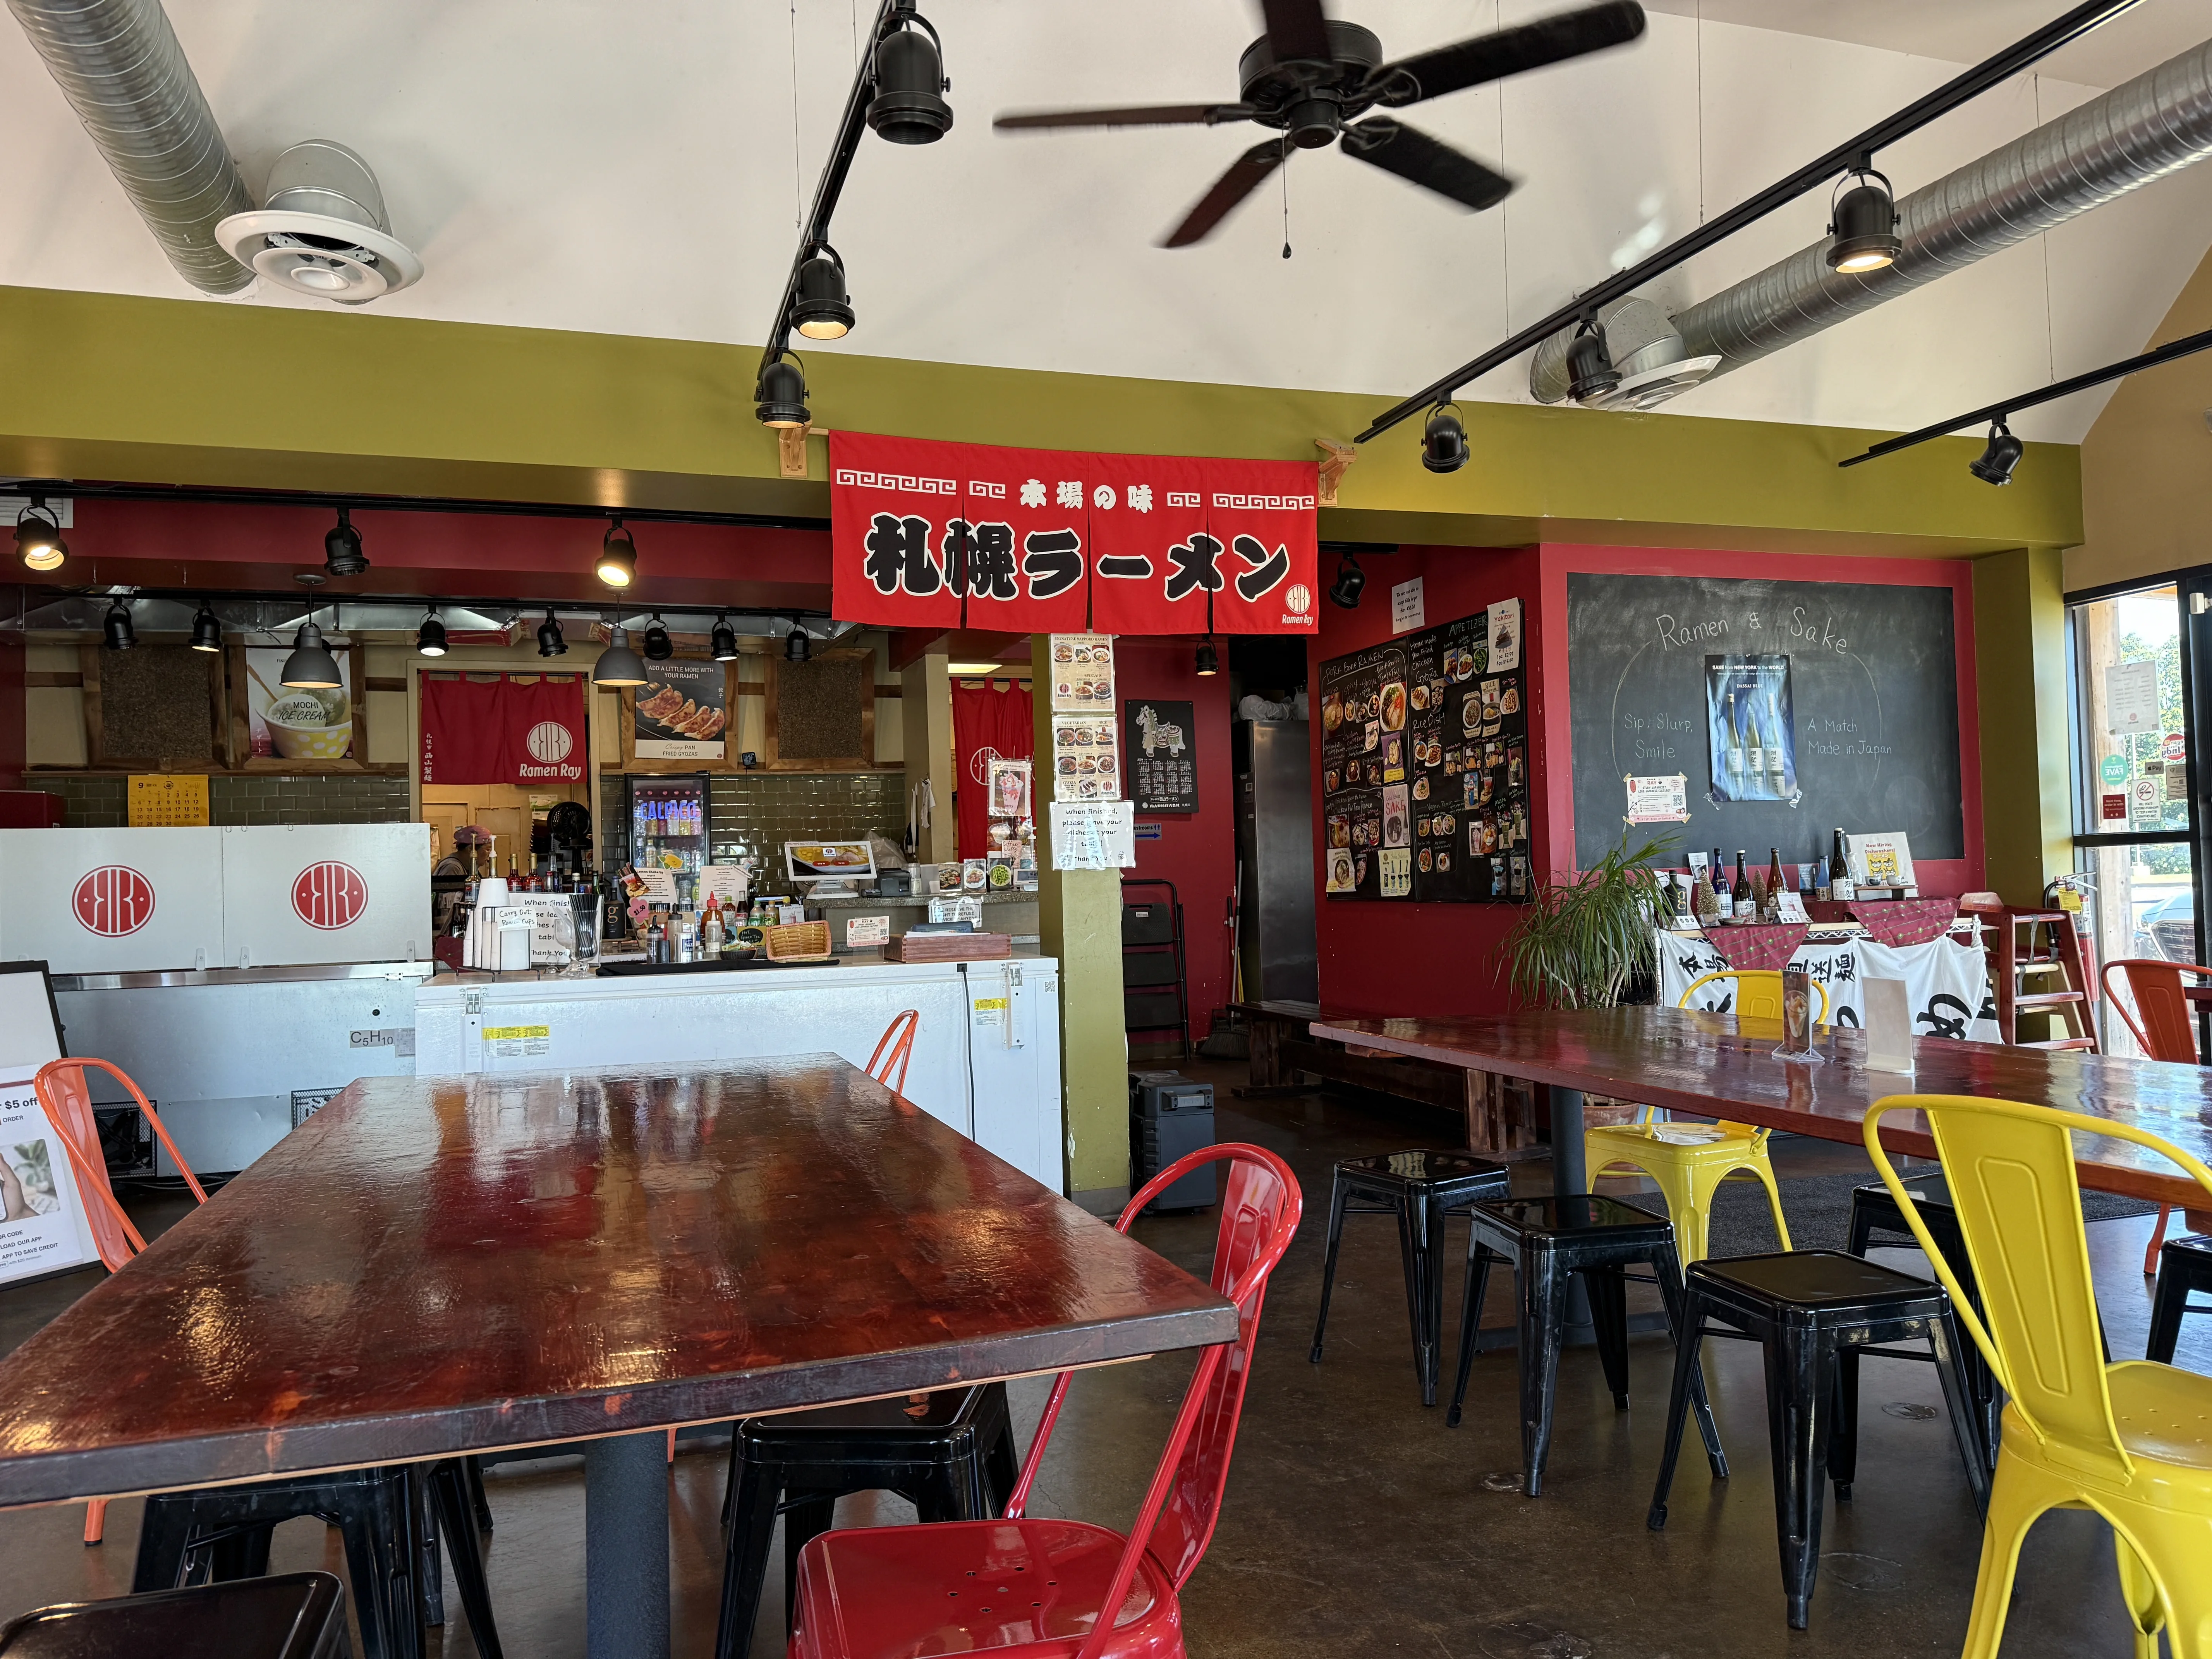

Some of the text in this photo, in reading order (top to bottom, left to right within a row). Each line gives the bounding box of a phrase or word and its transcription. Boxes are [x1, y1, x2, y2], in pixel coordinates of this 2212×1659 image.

[1020, 478, 1153, 514] 本場の味
[863, 511, 1290, 603] 札幌ラーメン
[1282, 614, 1313, 626] Ramen Ray
[1494, 613, 1514, 622] Yakitori
[1656, 613, 1729, 651] Ramen
[1790, 606, 1847, 655] Sake
[279, 711, 331, 721] ICE CREAM
[1657, 712, 1692, 733] Slurp,
[1808, 719, 1858, 734] A Match
[1635, 738, 1675, 759] Smile
[1808, 740, 1892, 757] Made in Japan
[519, 763, 581, 780] Ramen Ray
[640, 801, 696, 820] CALPICO
[1386, 800, 1405, 815] SAKE
[607, 907, 618, 923] g
[634, 905, 646, 915] $1.50
[522, 918, 534, 927] Cups
[5, 1097, 38, 1109] $5 off
[39, 1243, 58, 1251] CREDIT
